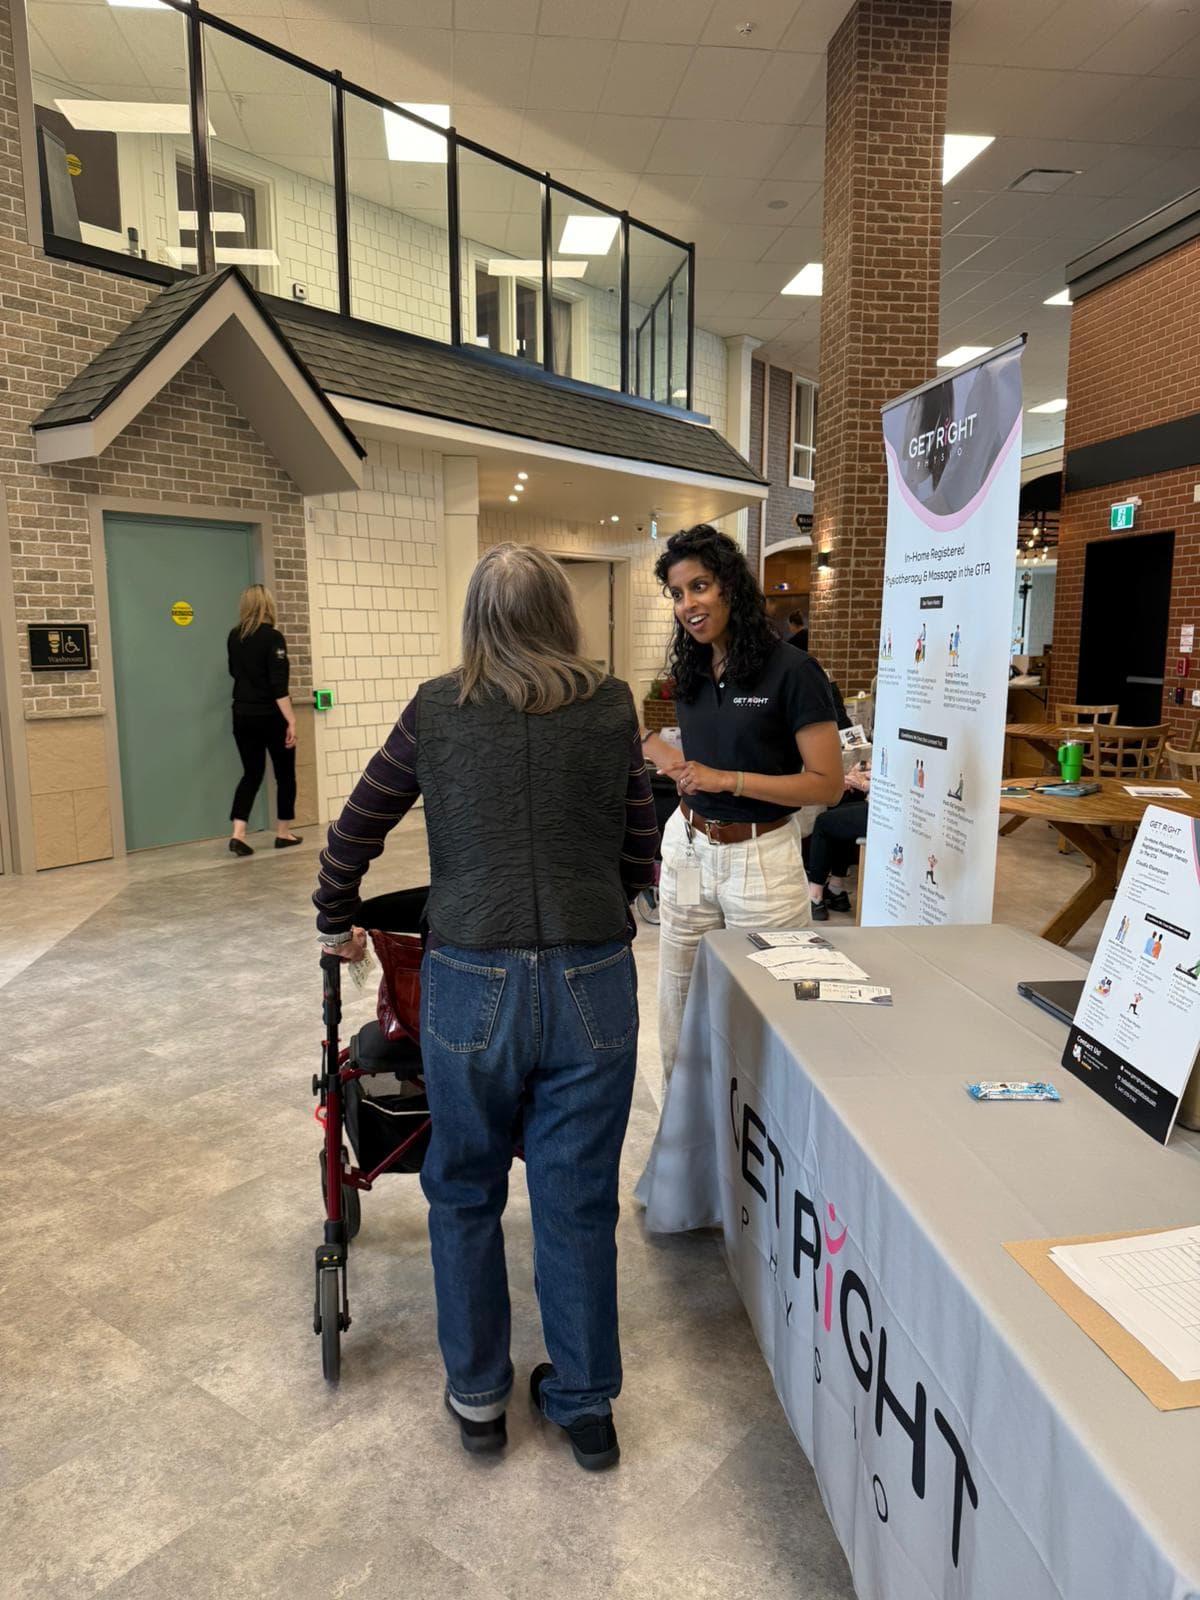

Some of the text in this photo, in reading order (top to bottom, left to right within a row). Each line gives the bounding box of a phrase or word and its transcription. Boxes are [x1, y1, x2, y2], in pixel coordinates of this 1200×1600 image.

[909, 413, 977, 458] GET RIGHT
[904, 543, 966, 563] In-Home Registered
[923, 570, 928, 582] &
[928, 569, 957, 582] Massage
[958, 566, 964, 577] in
[964, 565, 975, 577] the
[975, 562, 991, 576] GTA
[1149, 820, 1162, 831] GET
[1076, 1035, 1094, 1053] Contact
[741, 1205, 889, 1524] PHYSIO
[793, 1189, 979, 1569] RIGHT
